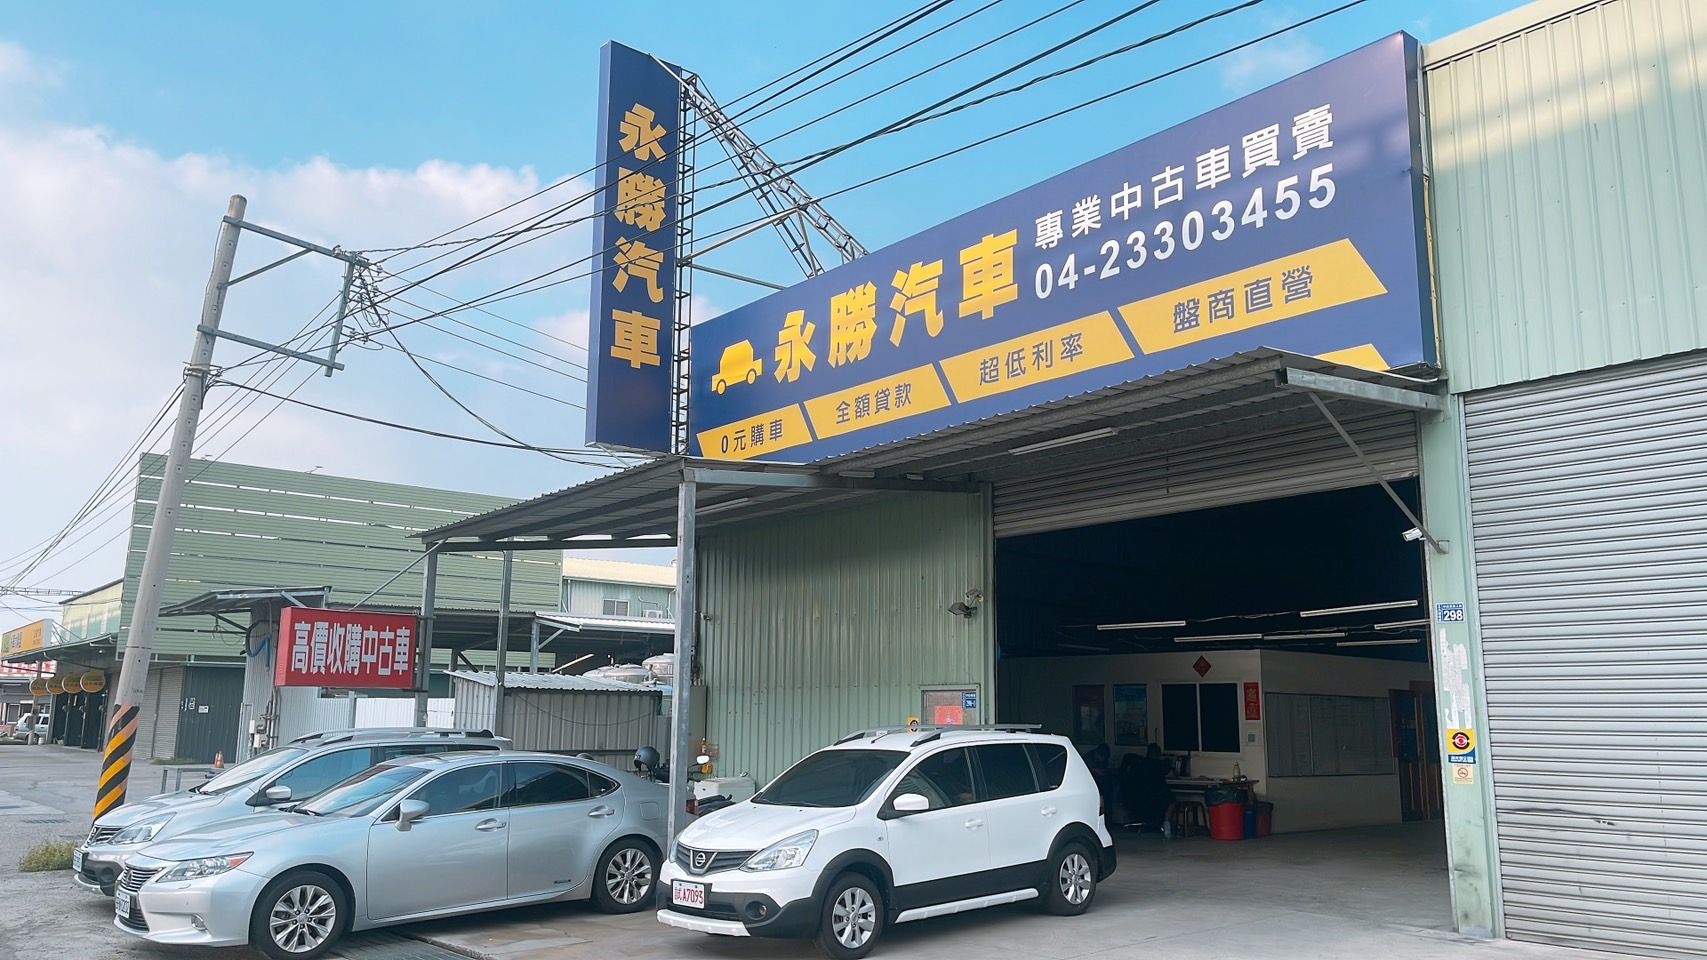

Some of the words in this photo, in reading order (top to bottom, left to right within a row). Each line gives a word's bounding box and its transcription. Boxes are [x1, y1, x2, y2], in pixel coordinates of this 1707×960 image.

[1034, 103, 1333, 251] 專業中古車買賣
[611, 103, 667, 369] 永勝汽車
[1034, 162, 1337, 299] 04-23303455
[774, 229, 1019, 385] 永勝汽車
[1173, 265, 1313, 334] 盤商直營
[979, 333, 1084, 386] 超低利率
[835, 383, 912, 425] 全額貸款
[721, 418, 783, 454] 0元購車
[1443, 609, 1463, 621] 298
[291, 621, 411, 676] 高價收購中古車
